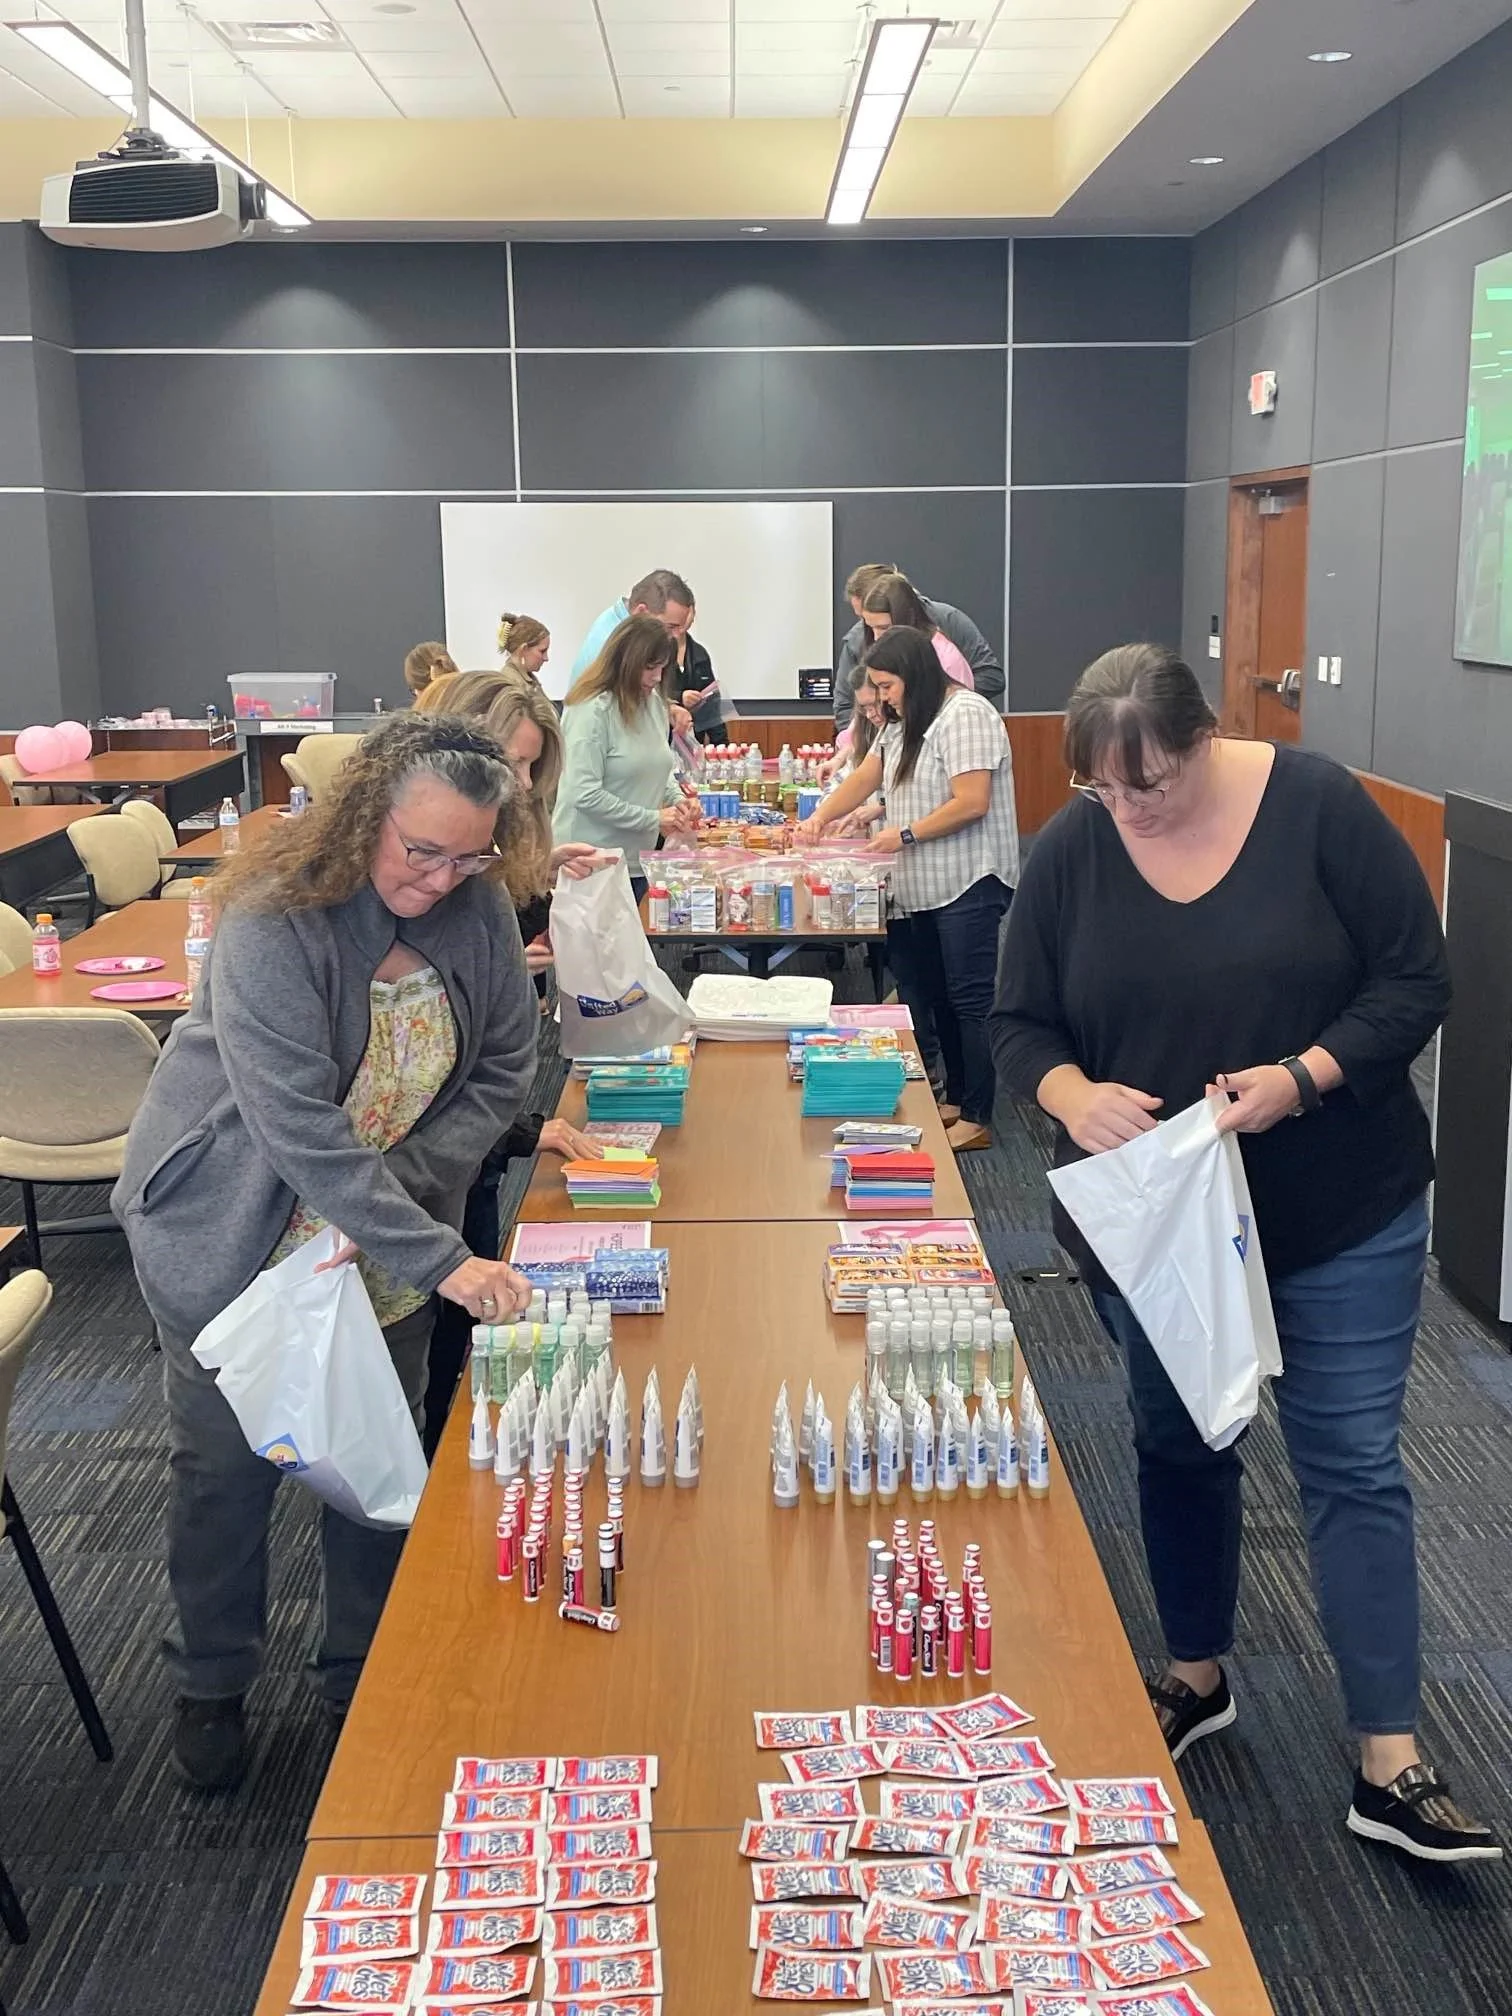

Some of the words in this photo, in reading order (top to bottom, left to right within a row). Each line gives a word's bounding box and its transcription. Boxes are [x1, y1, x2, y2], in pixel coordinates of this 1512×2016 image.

[594, 1004, 619, 1016] Way
[773, 1720, 793, 1742] Wet
[874, 1710, 893, 1732] Wet
[891, 1711, 908, 1734] Ones
[902, 1743, 922, 1764] Wet
[919, 1743, 938, 1769] Ones
[901, 1792, 921, 1818] Wet
[918, 1793, 937, 1818] Ones
[872, 1823, 894, 1849] Wet
[362, 1881, 382, 1906] Ones
[379, 1883, 402, 1906] Wet
[598, 1869, 614, 1894] Ones
[612, 1871, 635, 1896] Wet
[880, 1909, 906, 1937] Wet
[1123, 1896, 1152, 1925] Ones
[358, 1921, 375, 1946] Ones
[374, 1922, 398, 1946] Wet
[482, 1916, 500, 1941] Ones
[498, 1917, 521, 1941] Wet
[771, 1914, 795, 1944] Wet
[792, 1914, 811, 1945] Ones
[898, 1910, 921, 1943] Ones
[1009, 1953, 1034, 1984] Wet
[1106, 1947, 1138, 1977] Wet
[1128, 1942, 1160, 1974] Ones
[350, 1967, 372, 1998] Ones
[369, 1971, 395, 1999] Wet
[471, 1960, 490, 1988] Ones
[488, 1961, 514, 1991] Wet
[600, 1959, 617, 1987] Ones
[776, 1959, 798, 1991] Wet
[795, 1960, 815, 1994] Ones
[900, 1960, 925, 1993] Wet
[920, 1958, 945, 1992] Ones
[1037, 1999, 1060, 2016] et
